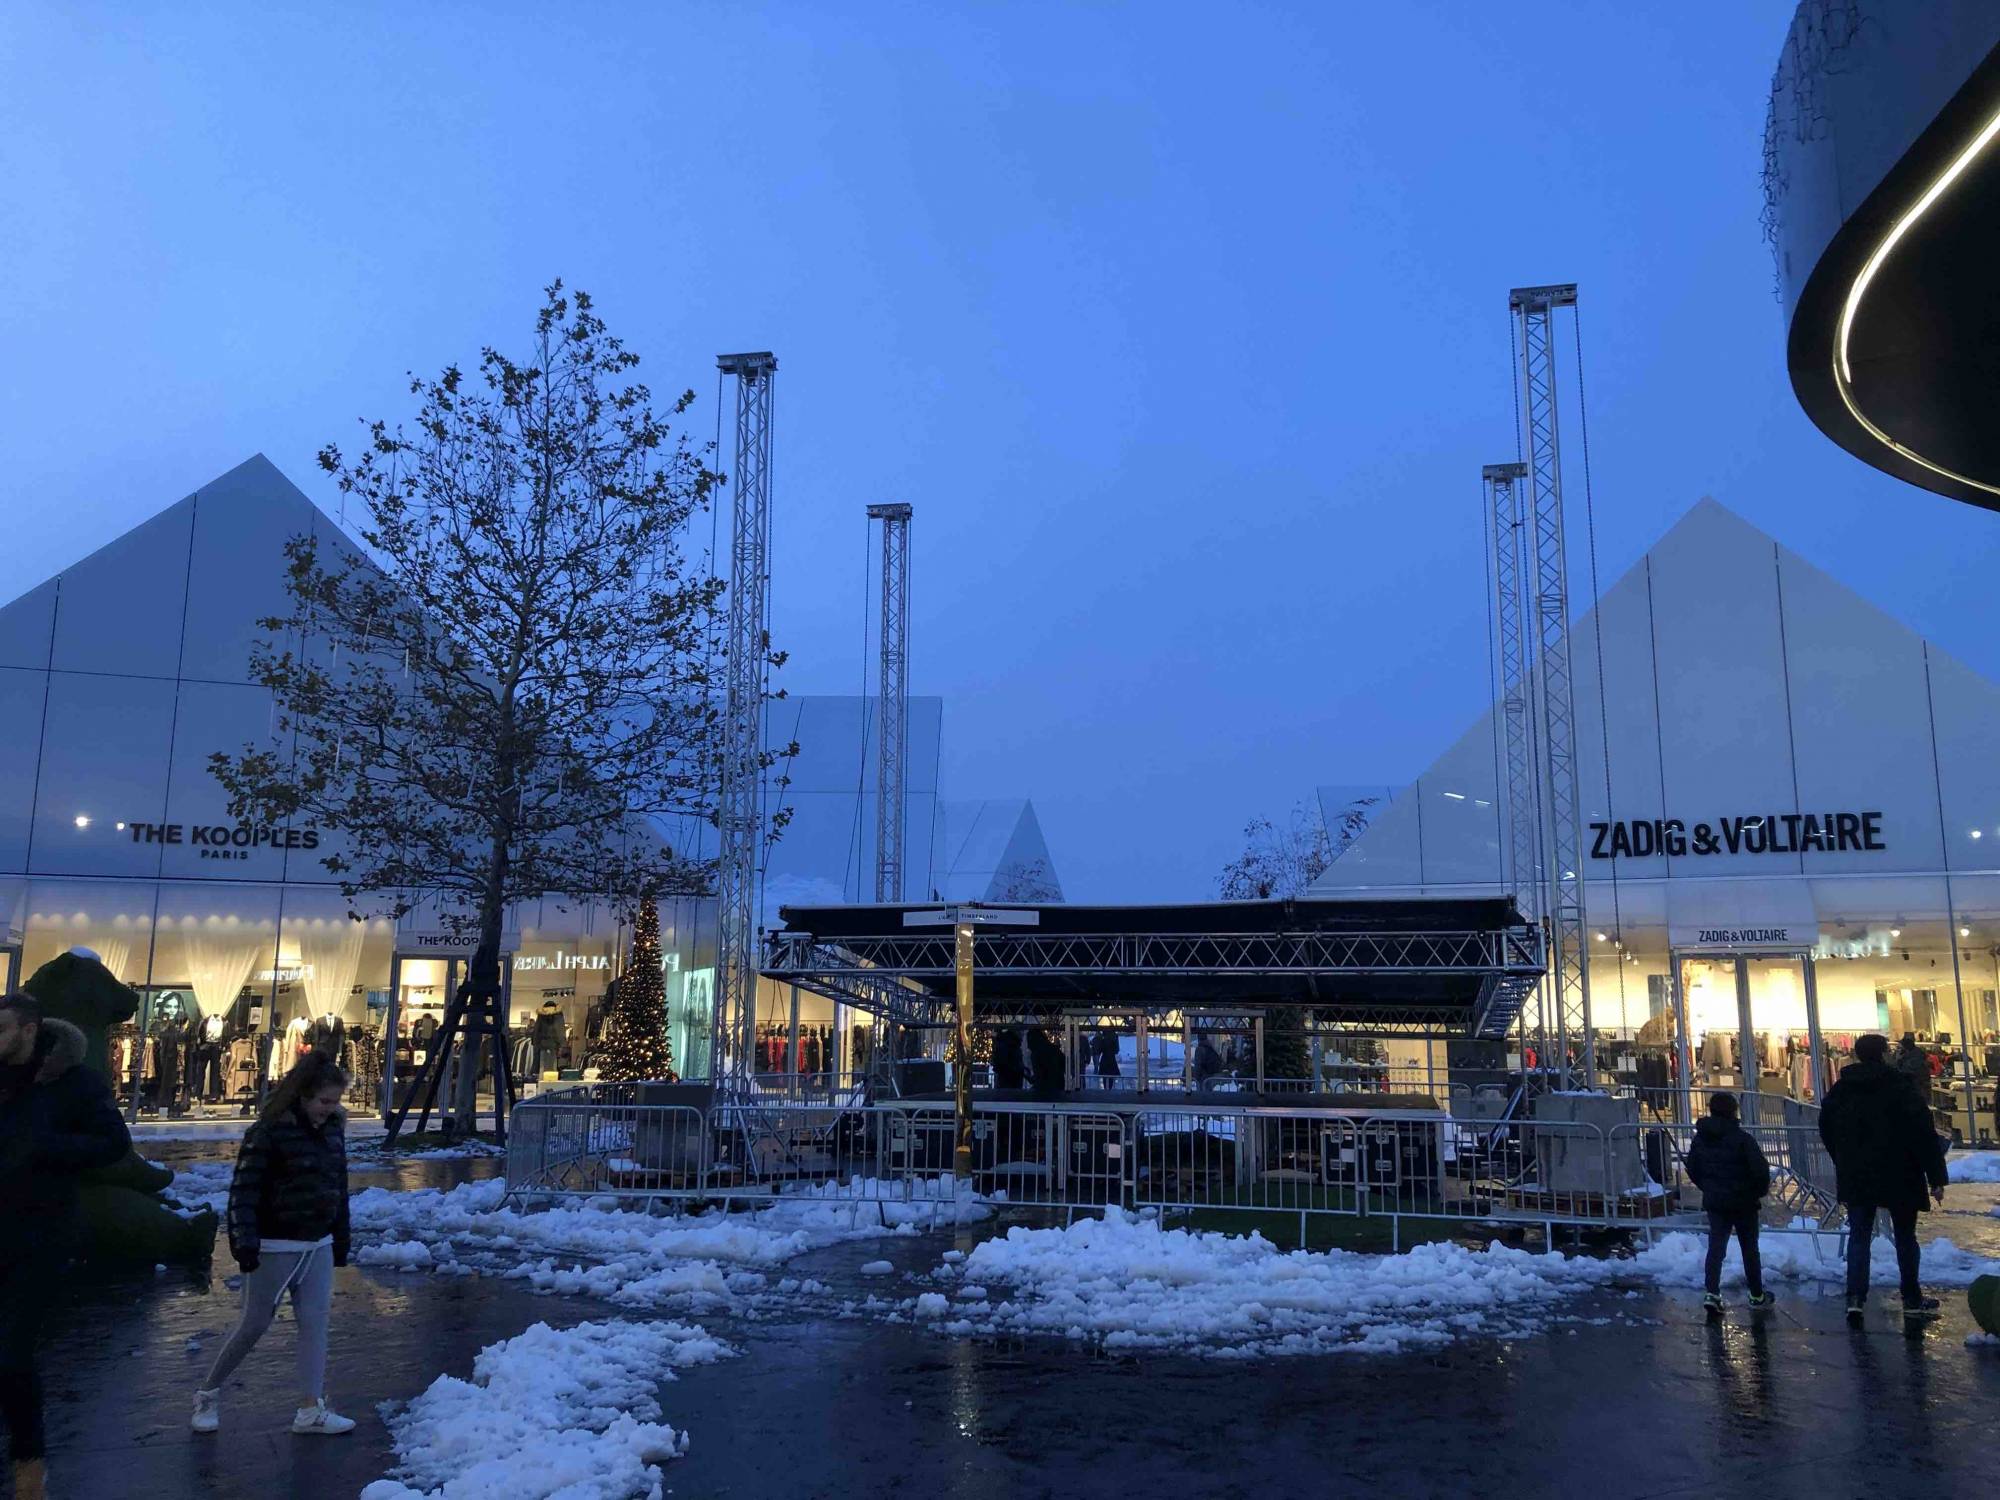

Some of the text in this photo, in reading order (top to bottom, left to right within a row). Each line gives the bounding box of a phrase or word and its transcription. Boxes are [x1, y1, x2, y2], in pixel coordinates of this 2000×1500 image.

[129, 823, 320, 849] THE KOOPLES
[200, 849, 248, 860] PARIS
[417, 936, 439, 946] THE
